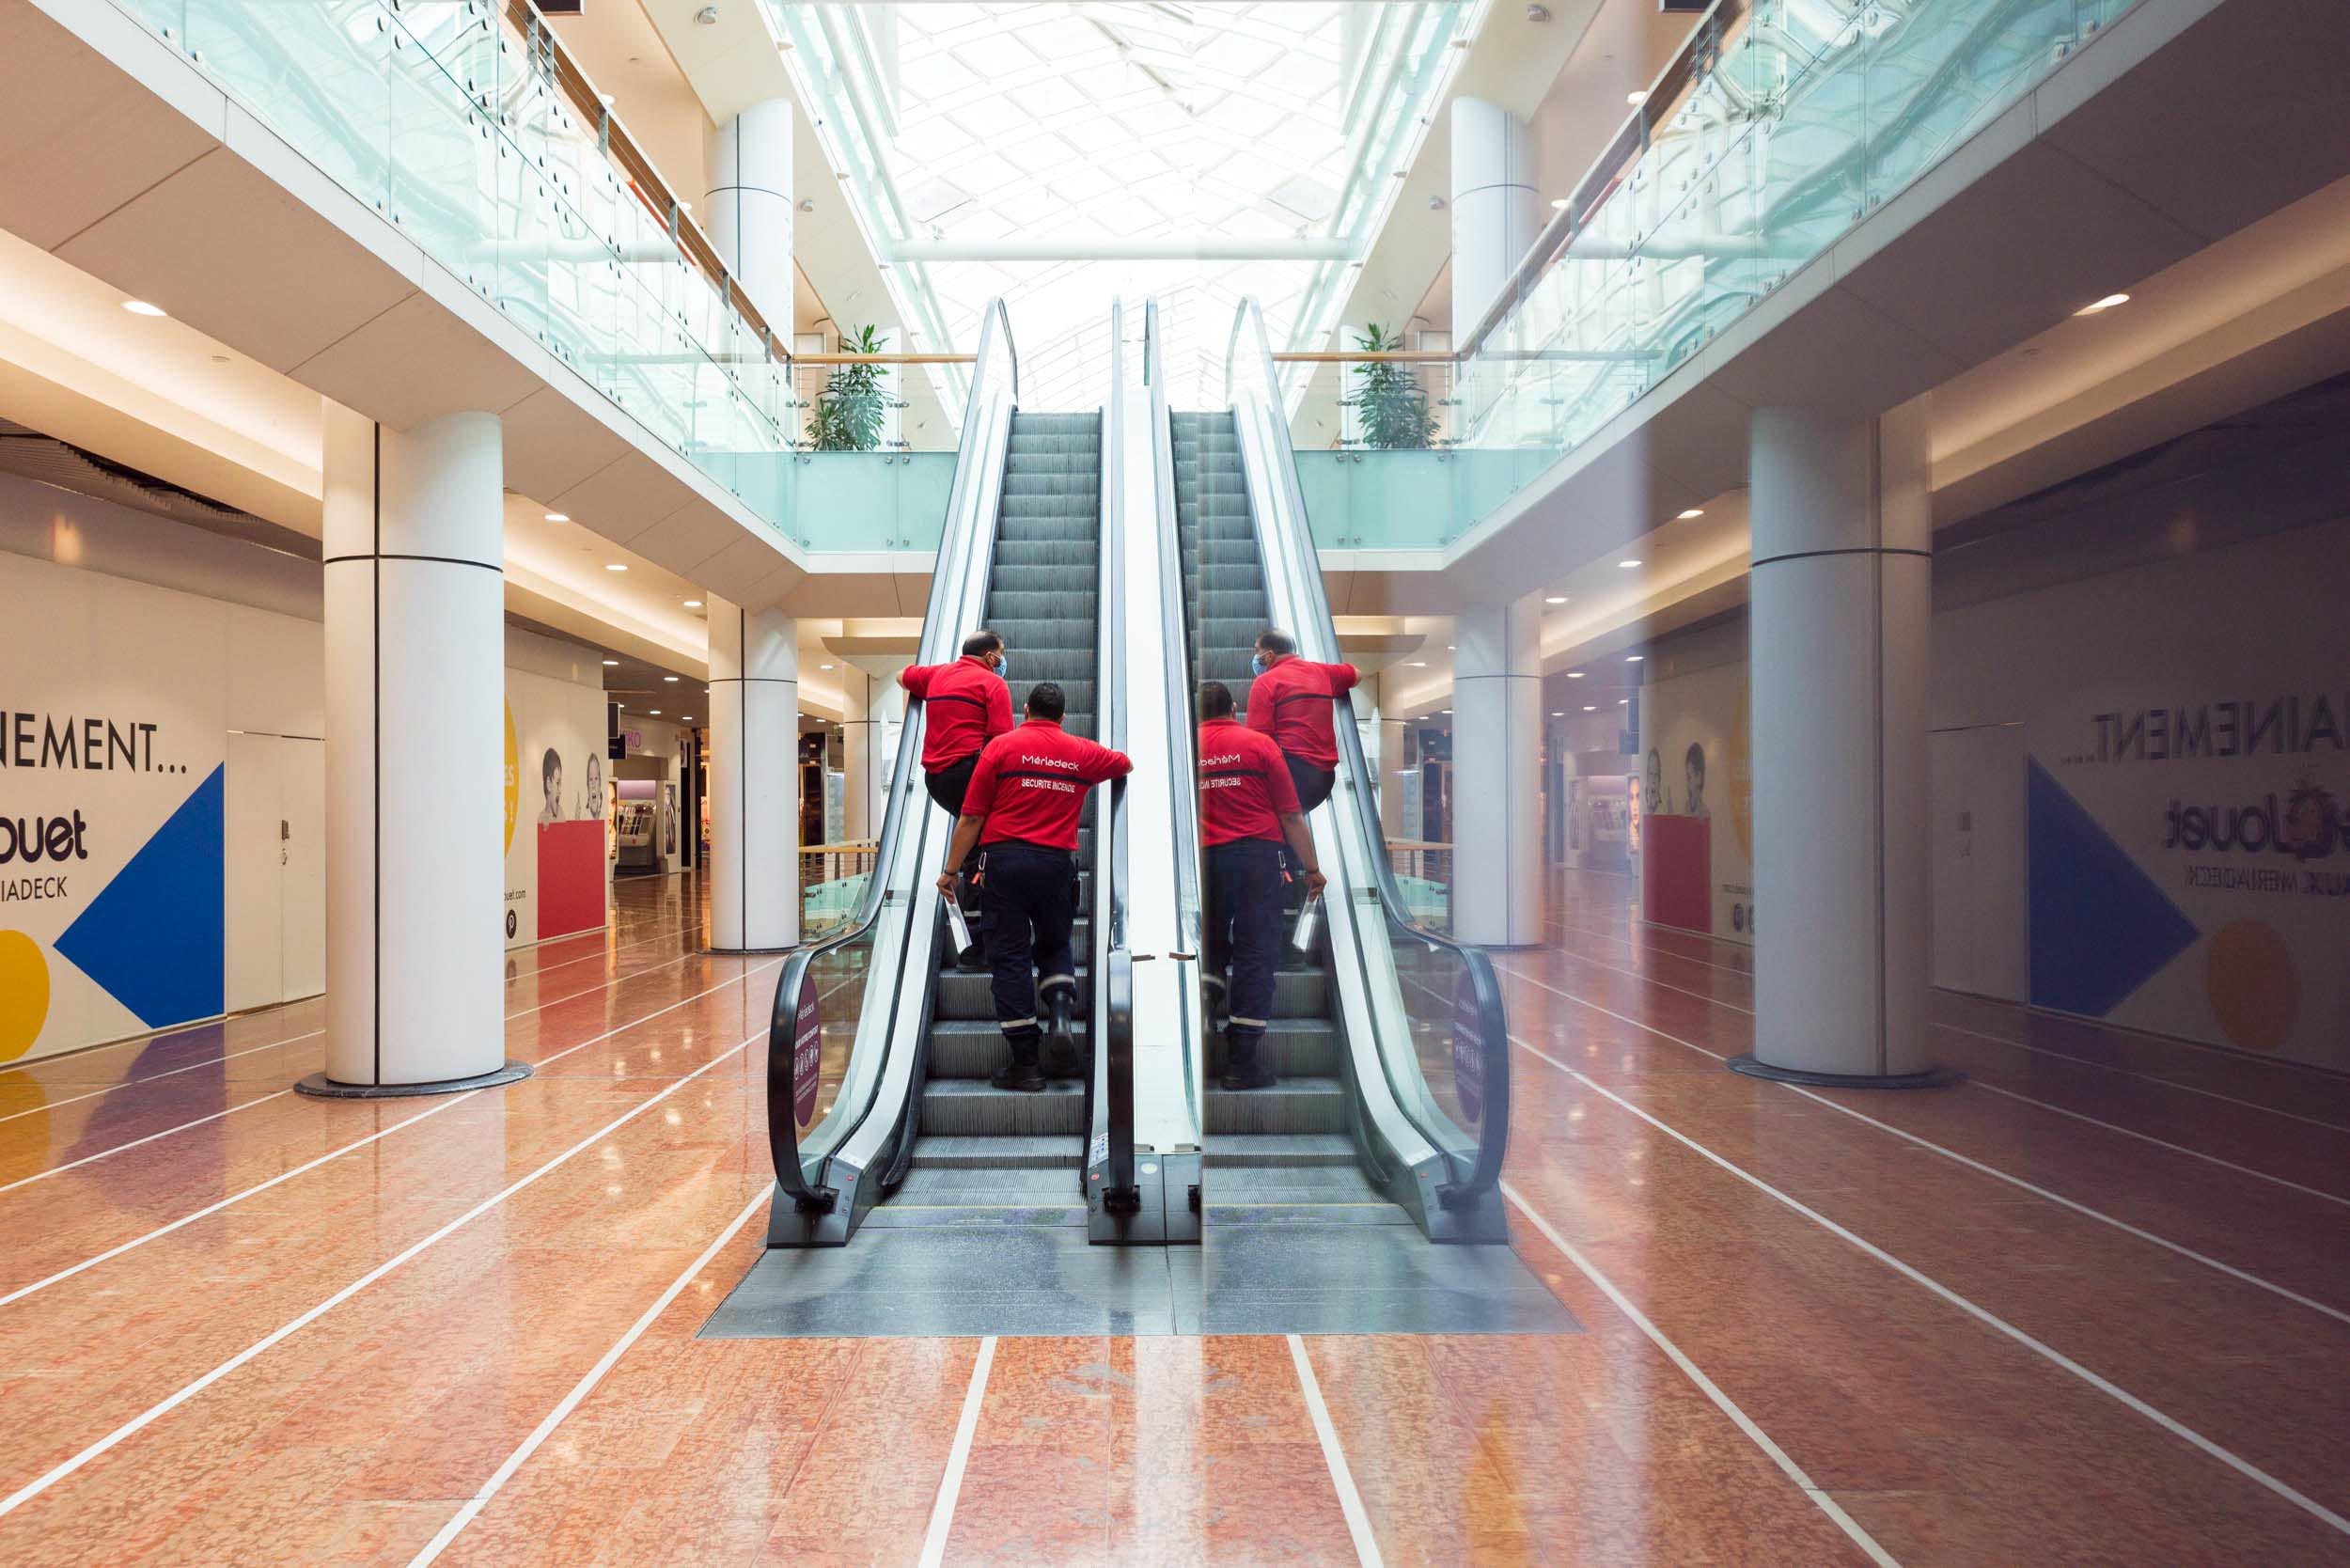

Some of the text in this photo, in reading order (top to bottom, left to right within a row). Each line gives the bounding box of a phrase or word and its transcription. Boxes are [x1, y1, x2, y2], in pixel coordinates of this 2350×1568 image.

[0, 712, 187, 774] EMENT...
[1022, 755, 1079, 772] Mériadeck
[1021, 778, 1075, 792] SECURITE INCENDIE
[1, 876, 68, 902] IADECK
